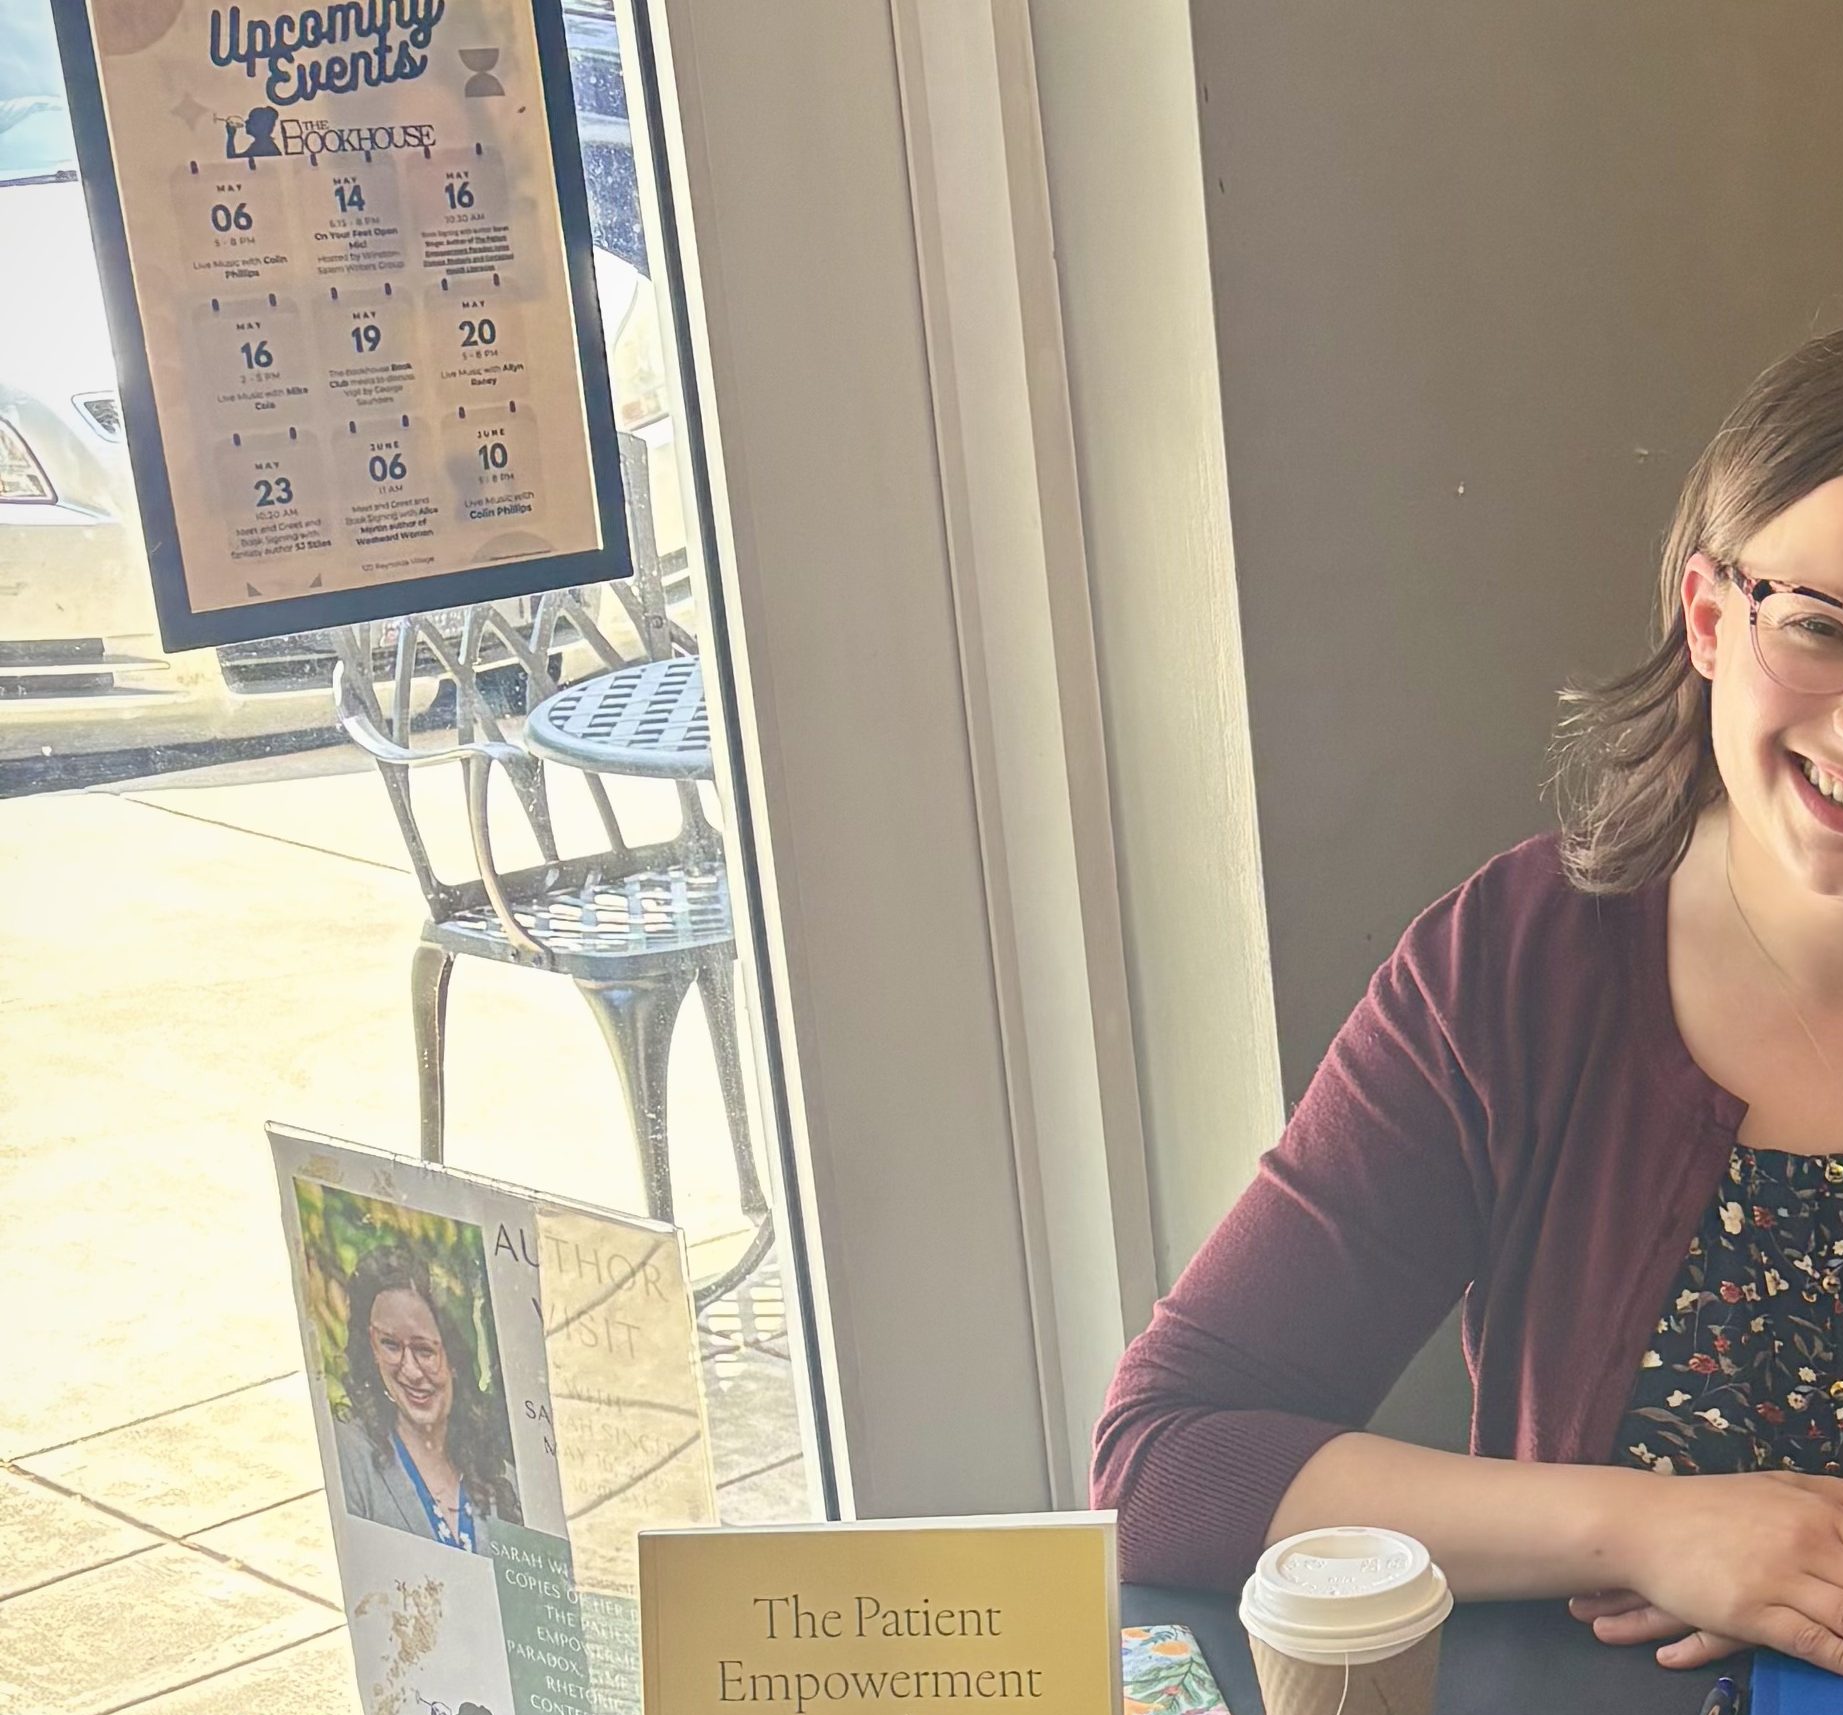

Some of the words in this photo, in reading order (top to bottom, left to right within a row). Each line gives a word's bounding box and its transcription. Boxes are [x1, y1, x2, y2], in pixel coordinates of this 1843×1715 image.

[266, 40, 428, 105] Events
[281, 120, 436, 155] BOOKHOUSE
[303, 120, 330, 130] THE
[217, 184, 242, 192] MAY
[333, 177, 357, 185] MAY
[334, 185, 365, 212] 14
[445, 182, 474, 209] 16
[211, 202, 253, 232] 06
[352, 325, 381, 352] 19
[459, 319, 496, 347] 20
[241, 340, 273, 369] 16
[370, 442, 399, 450] JUNE
[477, 428, 505, 437] JUNE
[369, 453, 407, 481] 06
[479, 443, 508, 469] 10
[254, 478, 293, 507] 23
[470, 508, 494, 520] Colin
[490, 1541, 543, 1568] SARAH
[506, 1569, 560, 1599] COPIES
[545, 1605, 576, 1627] THE
[752, 1594, 844, 1641] The
[853, 1594, 1004, 1639] Patient
[717, 1661, 1043, 1715] Empowerment
